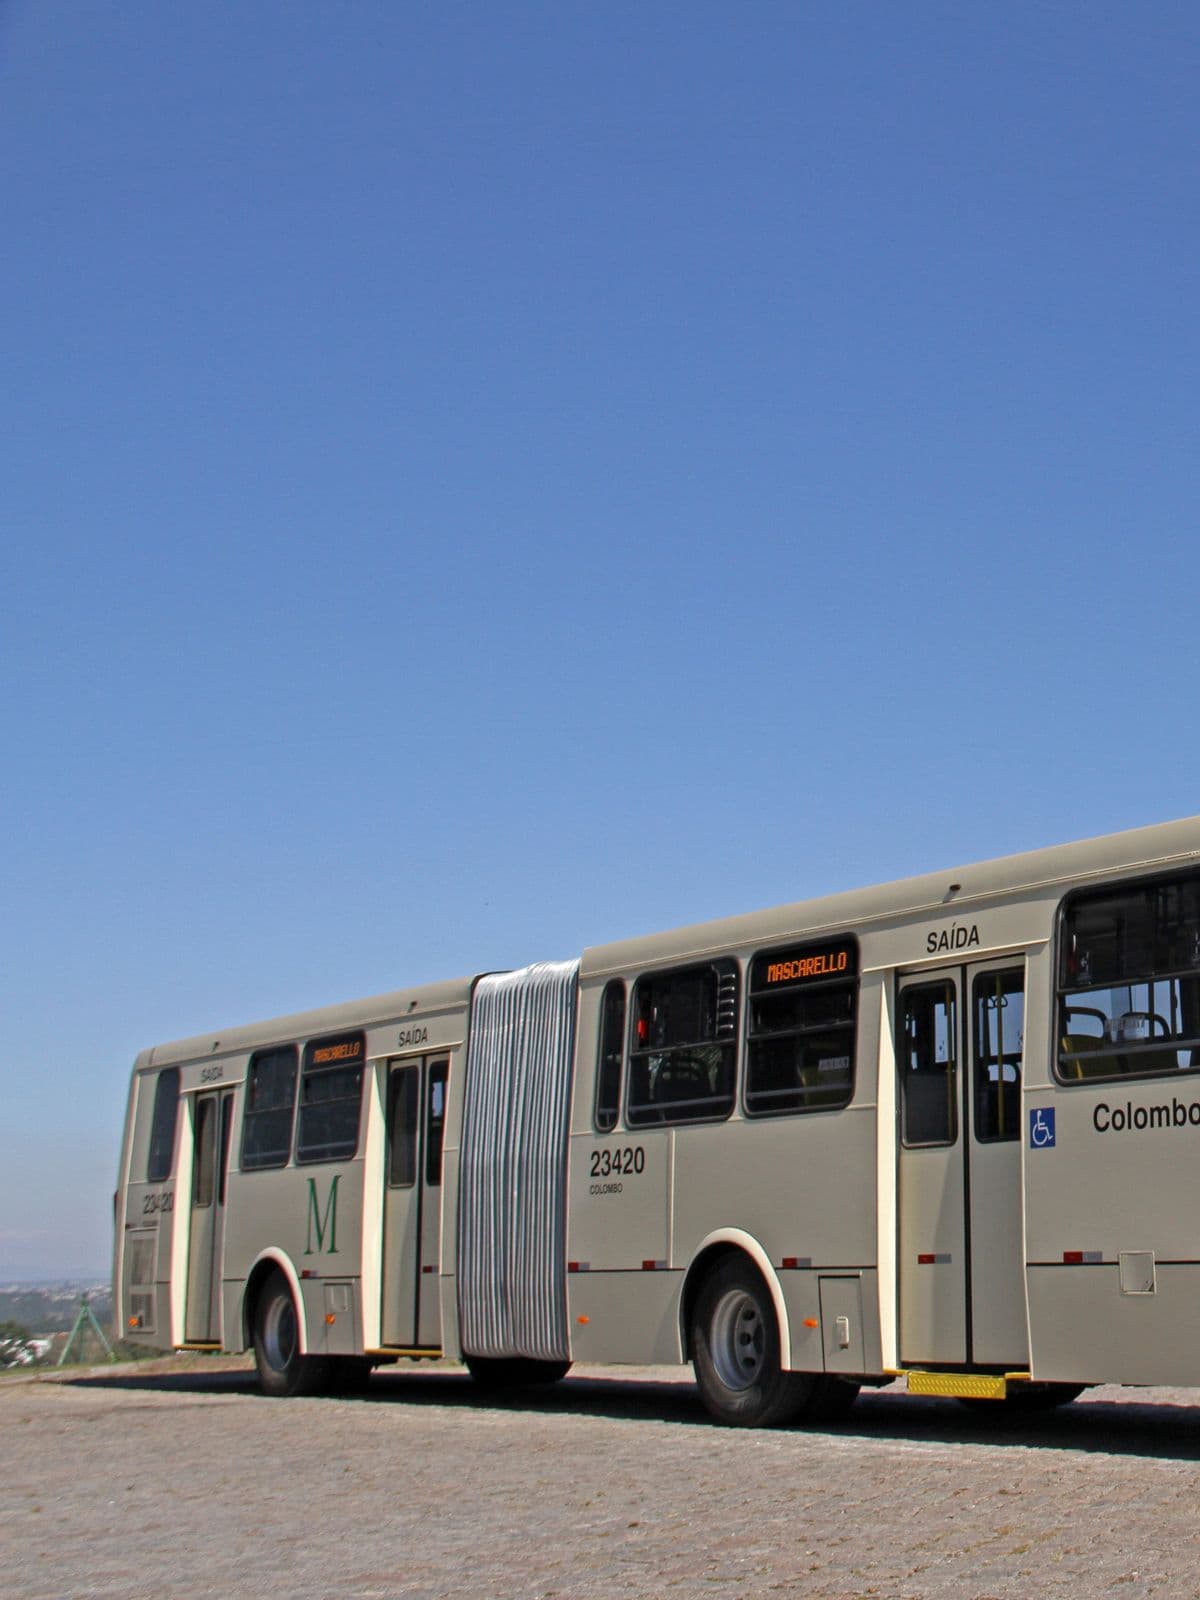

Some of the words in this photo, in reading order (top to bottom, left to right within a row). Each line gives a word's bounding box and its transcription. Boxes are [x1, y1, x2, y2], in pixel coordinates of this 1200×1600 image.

[926, 922, 980, 953] SAÍDA
[767, 952, 848, 983] MASCARELLO
[398, 1024, 428, 1047] SAÍDA
[590, 1146, 645, 1177] 23420
[589, 1182, 624, 1195] COLOMBO
[303, 1174, 343, 1255] M
